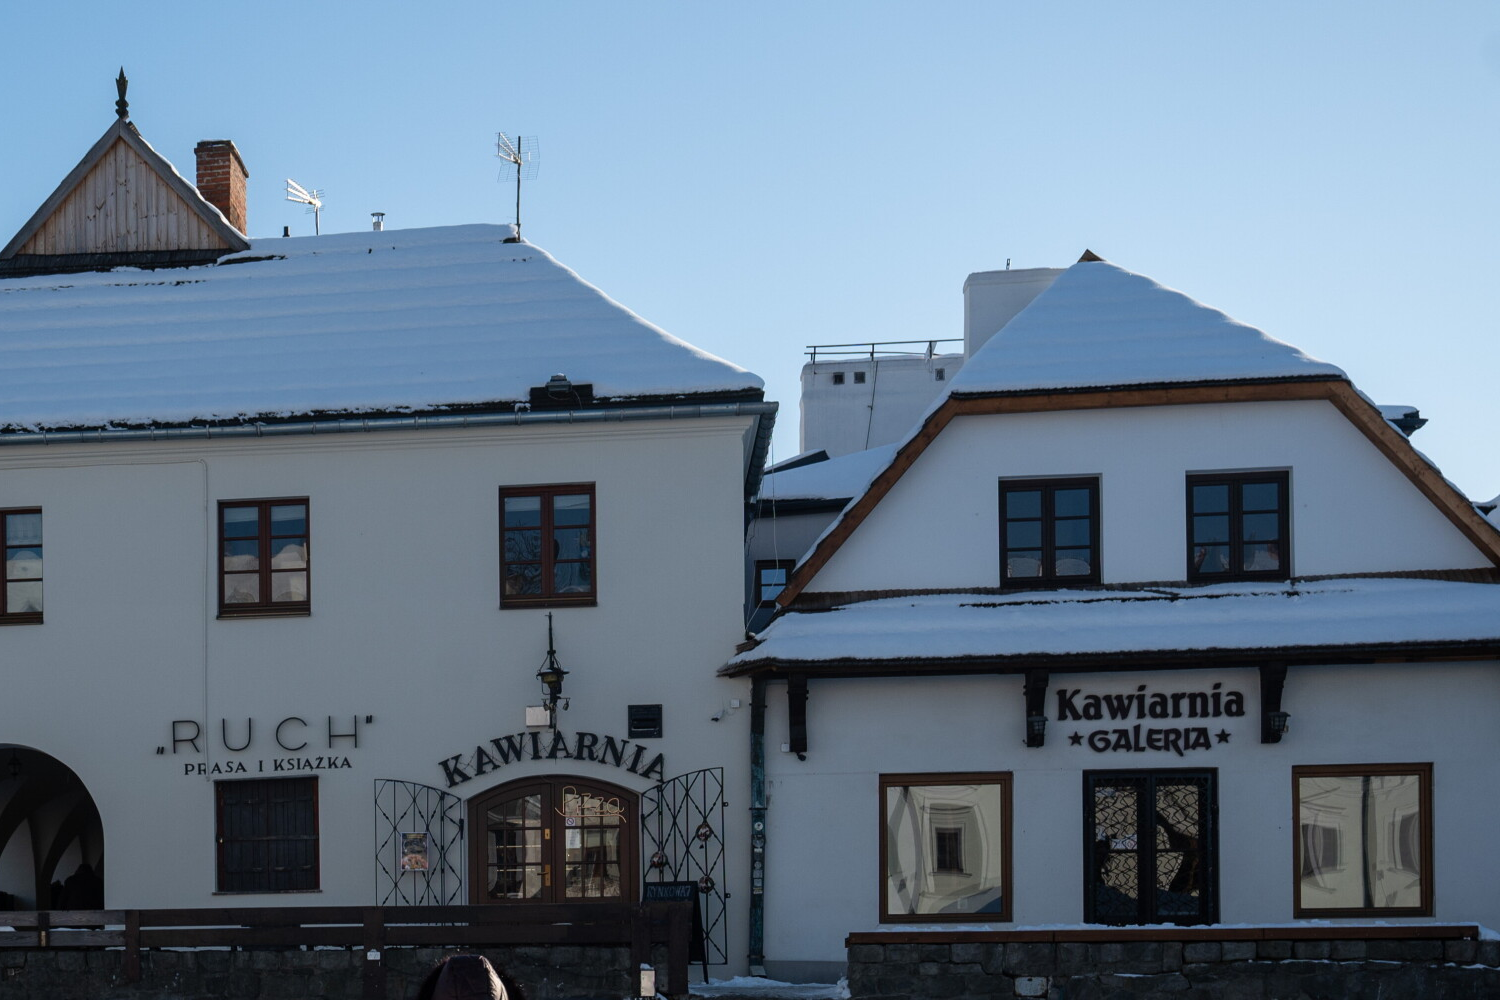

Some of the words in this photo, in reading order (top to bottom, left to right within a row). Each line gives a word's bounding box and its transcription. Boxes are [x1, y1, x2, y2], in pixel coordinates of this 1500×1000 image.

[1056, 682, 1245, 721] Kawiarnia
[1088, 724, 1212, 757] GALERIA
[184, 761, 247, 776] PRASA
[259, 760, 263, 772] I
[273, 756, 352, 772] KSIĄŻKA
[438, 730, 666, 788] KAWIARNIA
[560, 785, 626, 819] Pizza
